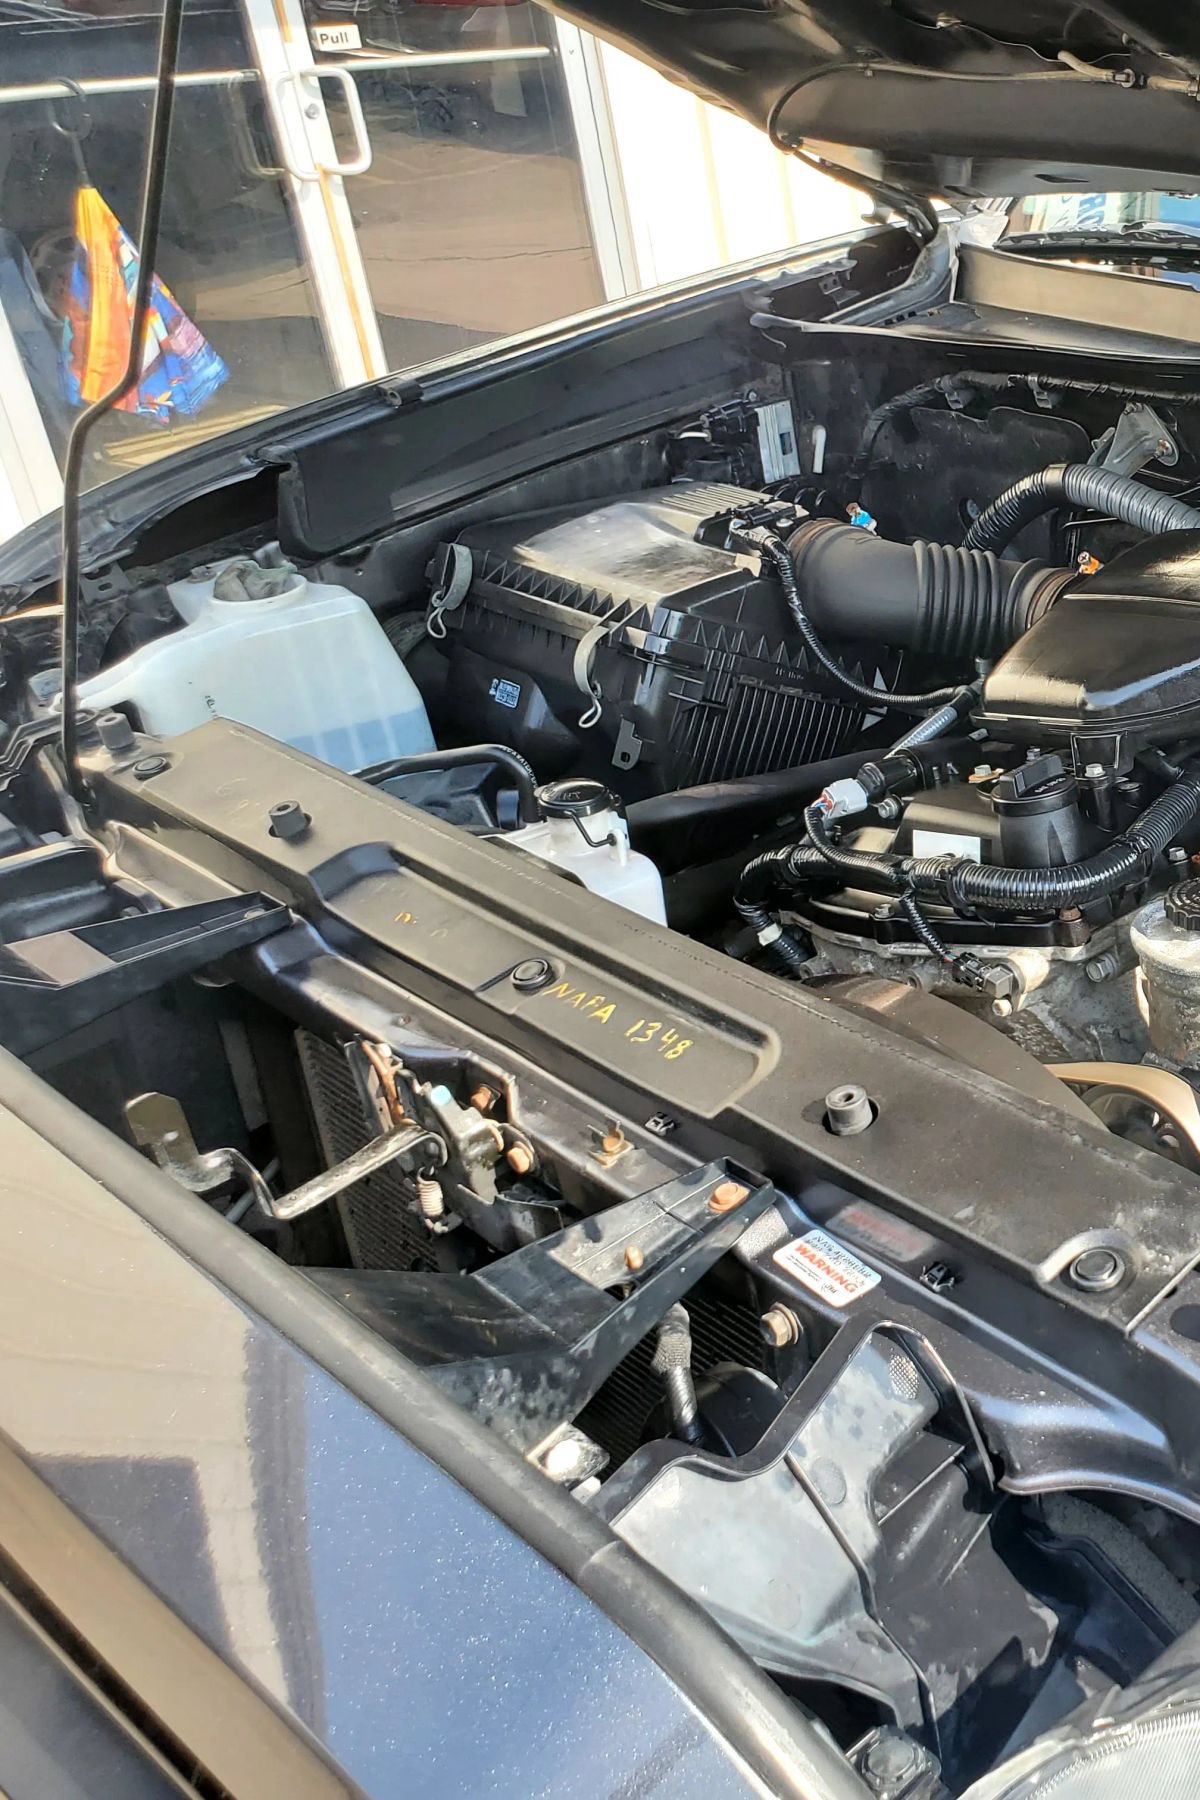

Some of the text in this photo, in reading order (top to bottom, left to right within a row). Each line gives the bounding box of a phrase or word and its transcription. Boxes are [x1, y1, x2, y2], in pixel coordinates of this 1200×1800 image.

[319, 31, 349, 45] Pull
[543, 982, 695, 1060] NAPA 1348
[793, 1241, 860, 1293] WARNING
